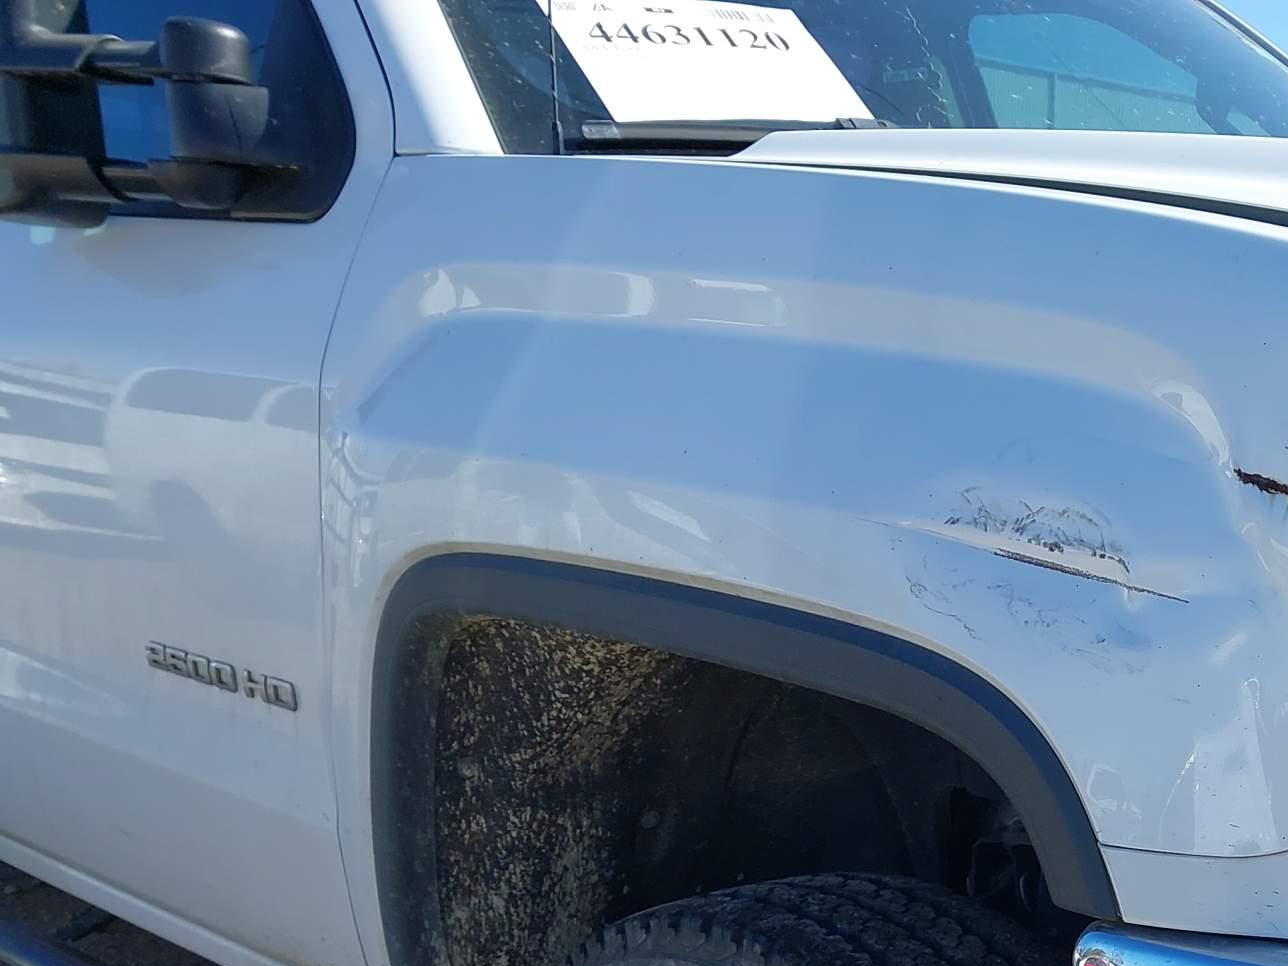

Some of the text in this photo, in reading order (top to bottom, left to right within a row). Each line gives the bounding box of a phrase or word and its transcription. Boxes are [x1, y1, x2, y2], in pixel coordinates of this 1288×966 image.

[588, 21, 791, 51] 44631120
[145, 640, 298, 712] 2500 HD
